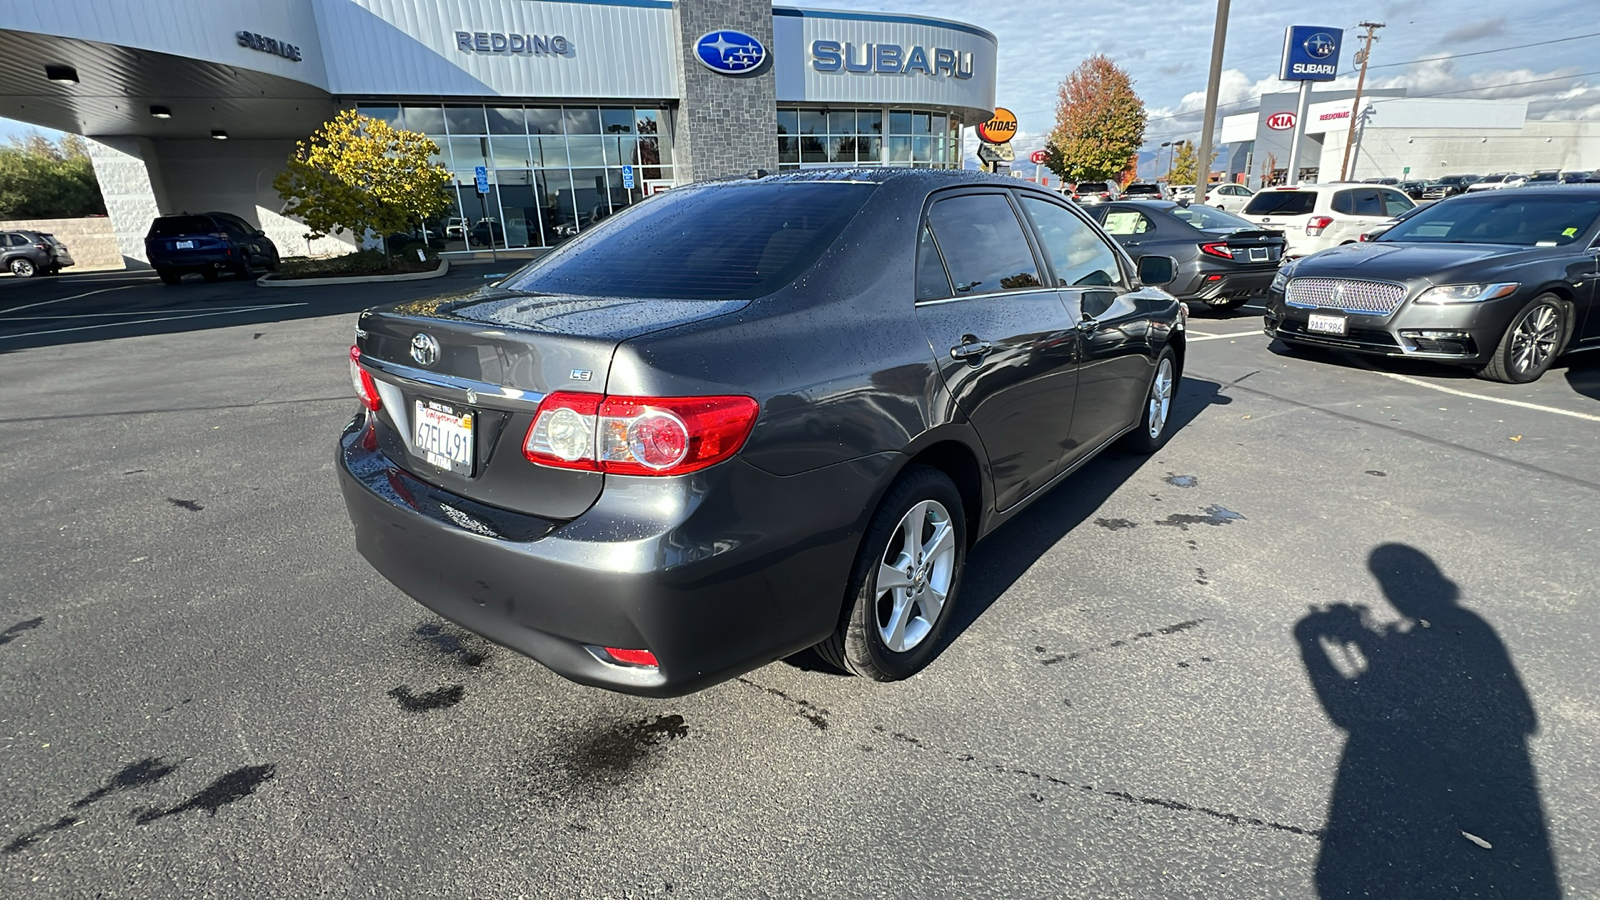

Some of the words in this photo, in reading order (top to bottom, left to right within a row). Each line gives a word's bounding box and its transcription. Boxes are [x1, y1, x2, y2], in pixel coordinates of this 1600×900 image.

[455, 31, 569, 55] REDDING
[812, 40, 974, 80] SUBARU
[1292, 63, 1335, 75] SUBARU
[1271, 115, 1293, 127] KIA
[1319, 111, 1350, 121] REDDING
[984, 120, 1016, 132] MIDAS
[572, 369, 590, 380] LE
[417, 422, 469, 467] 6ZFL491
